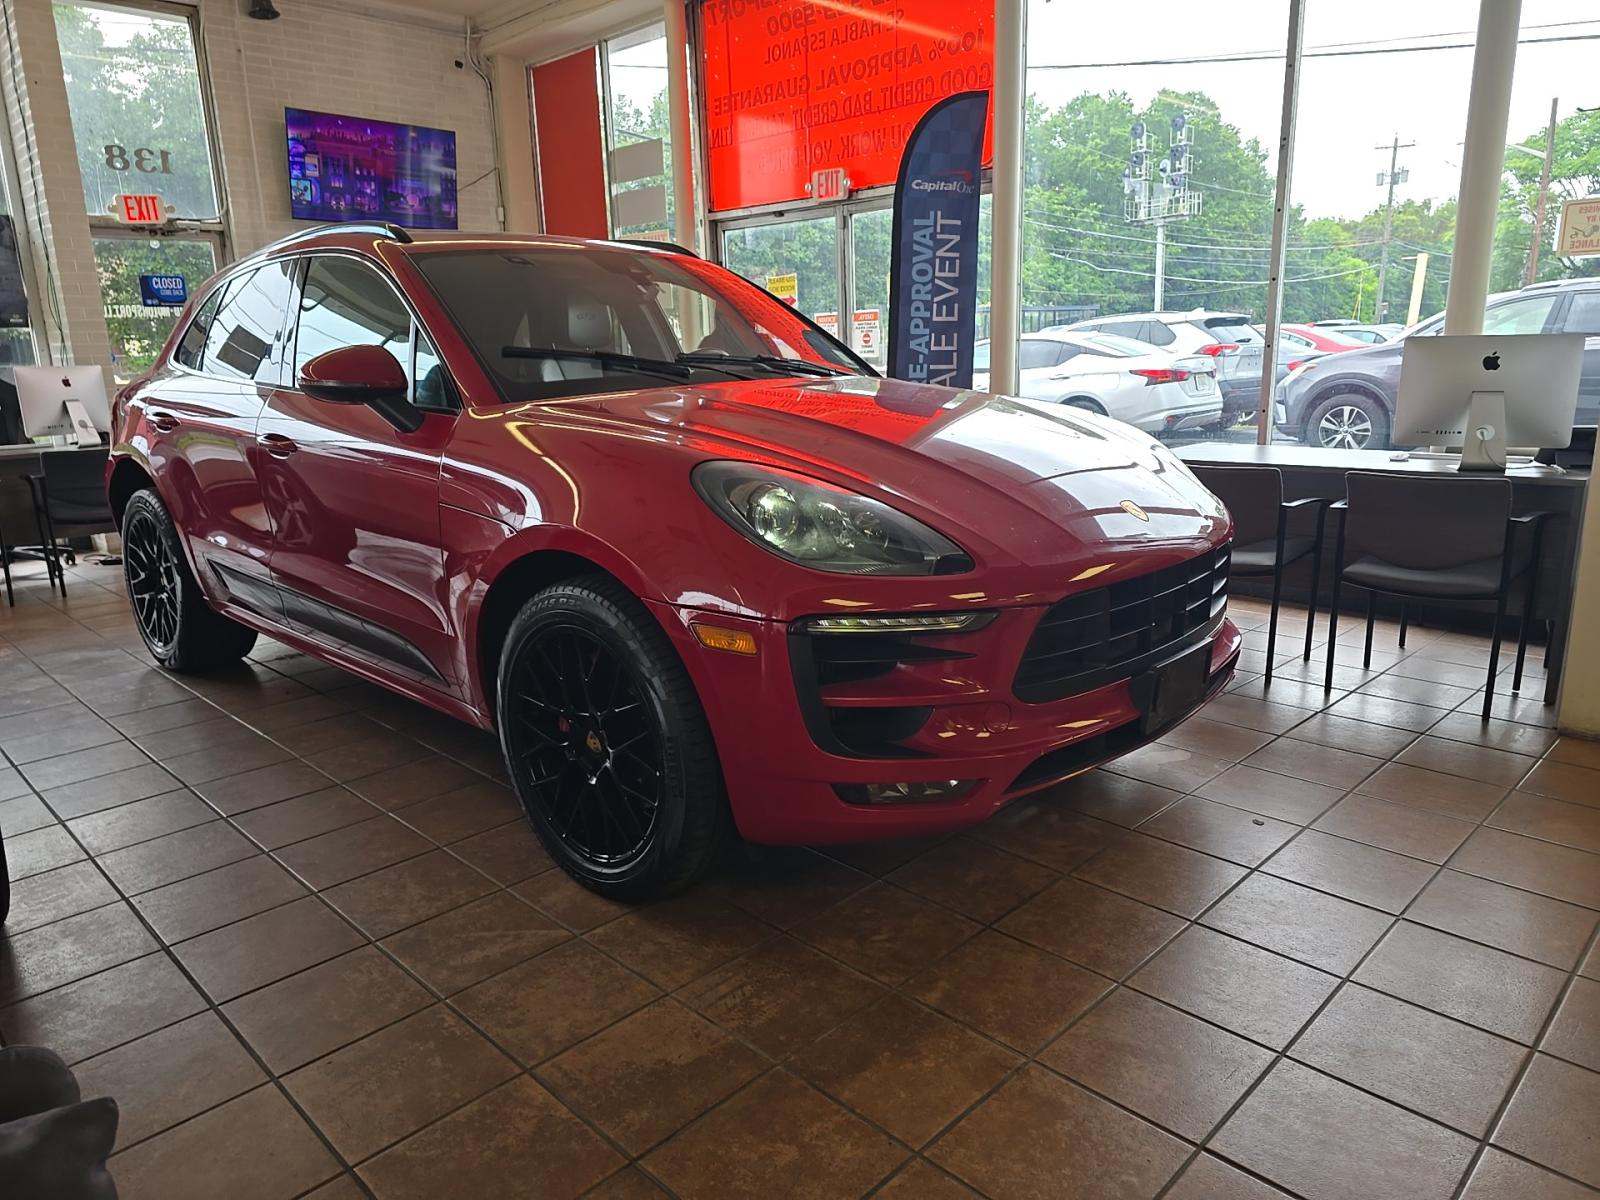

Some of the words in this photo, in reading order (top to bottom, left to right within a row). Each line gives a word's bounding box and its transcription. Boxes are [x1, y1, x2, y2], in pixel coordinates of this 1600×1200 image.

[817, 169, 841, 198] EXIT
[122, 195, 160, 221] EXIT
[152, 277, 183, 289] CLOSED
[932, 210, 962, 322] EVENT
[908, 210, 935, 384] E-APPROVAL
[930, 332, 958, 387] ALE
